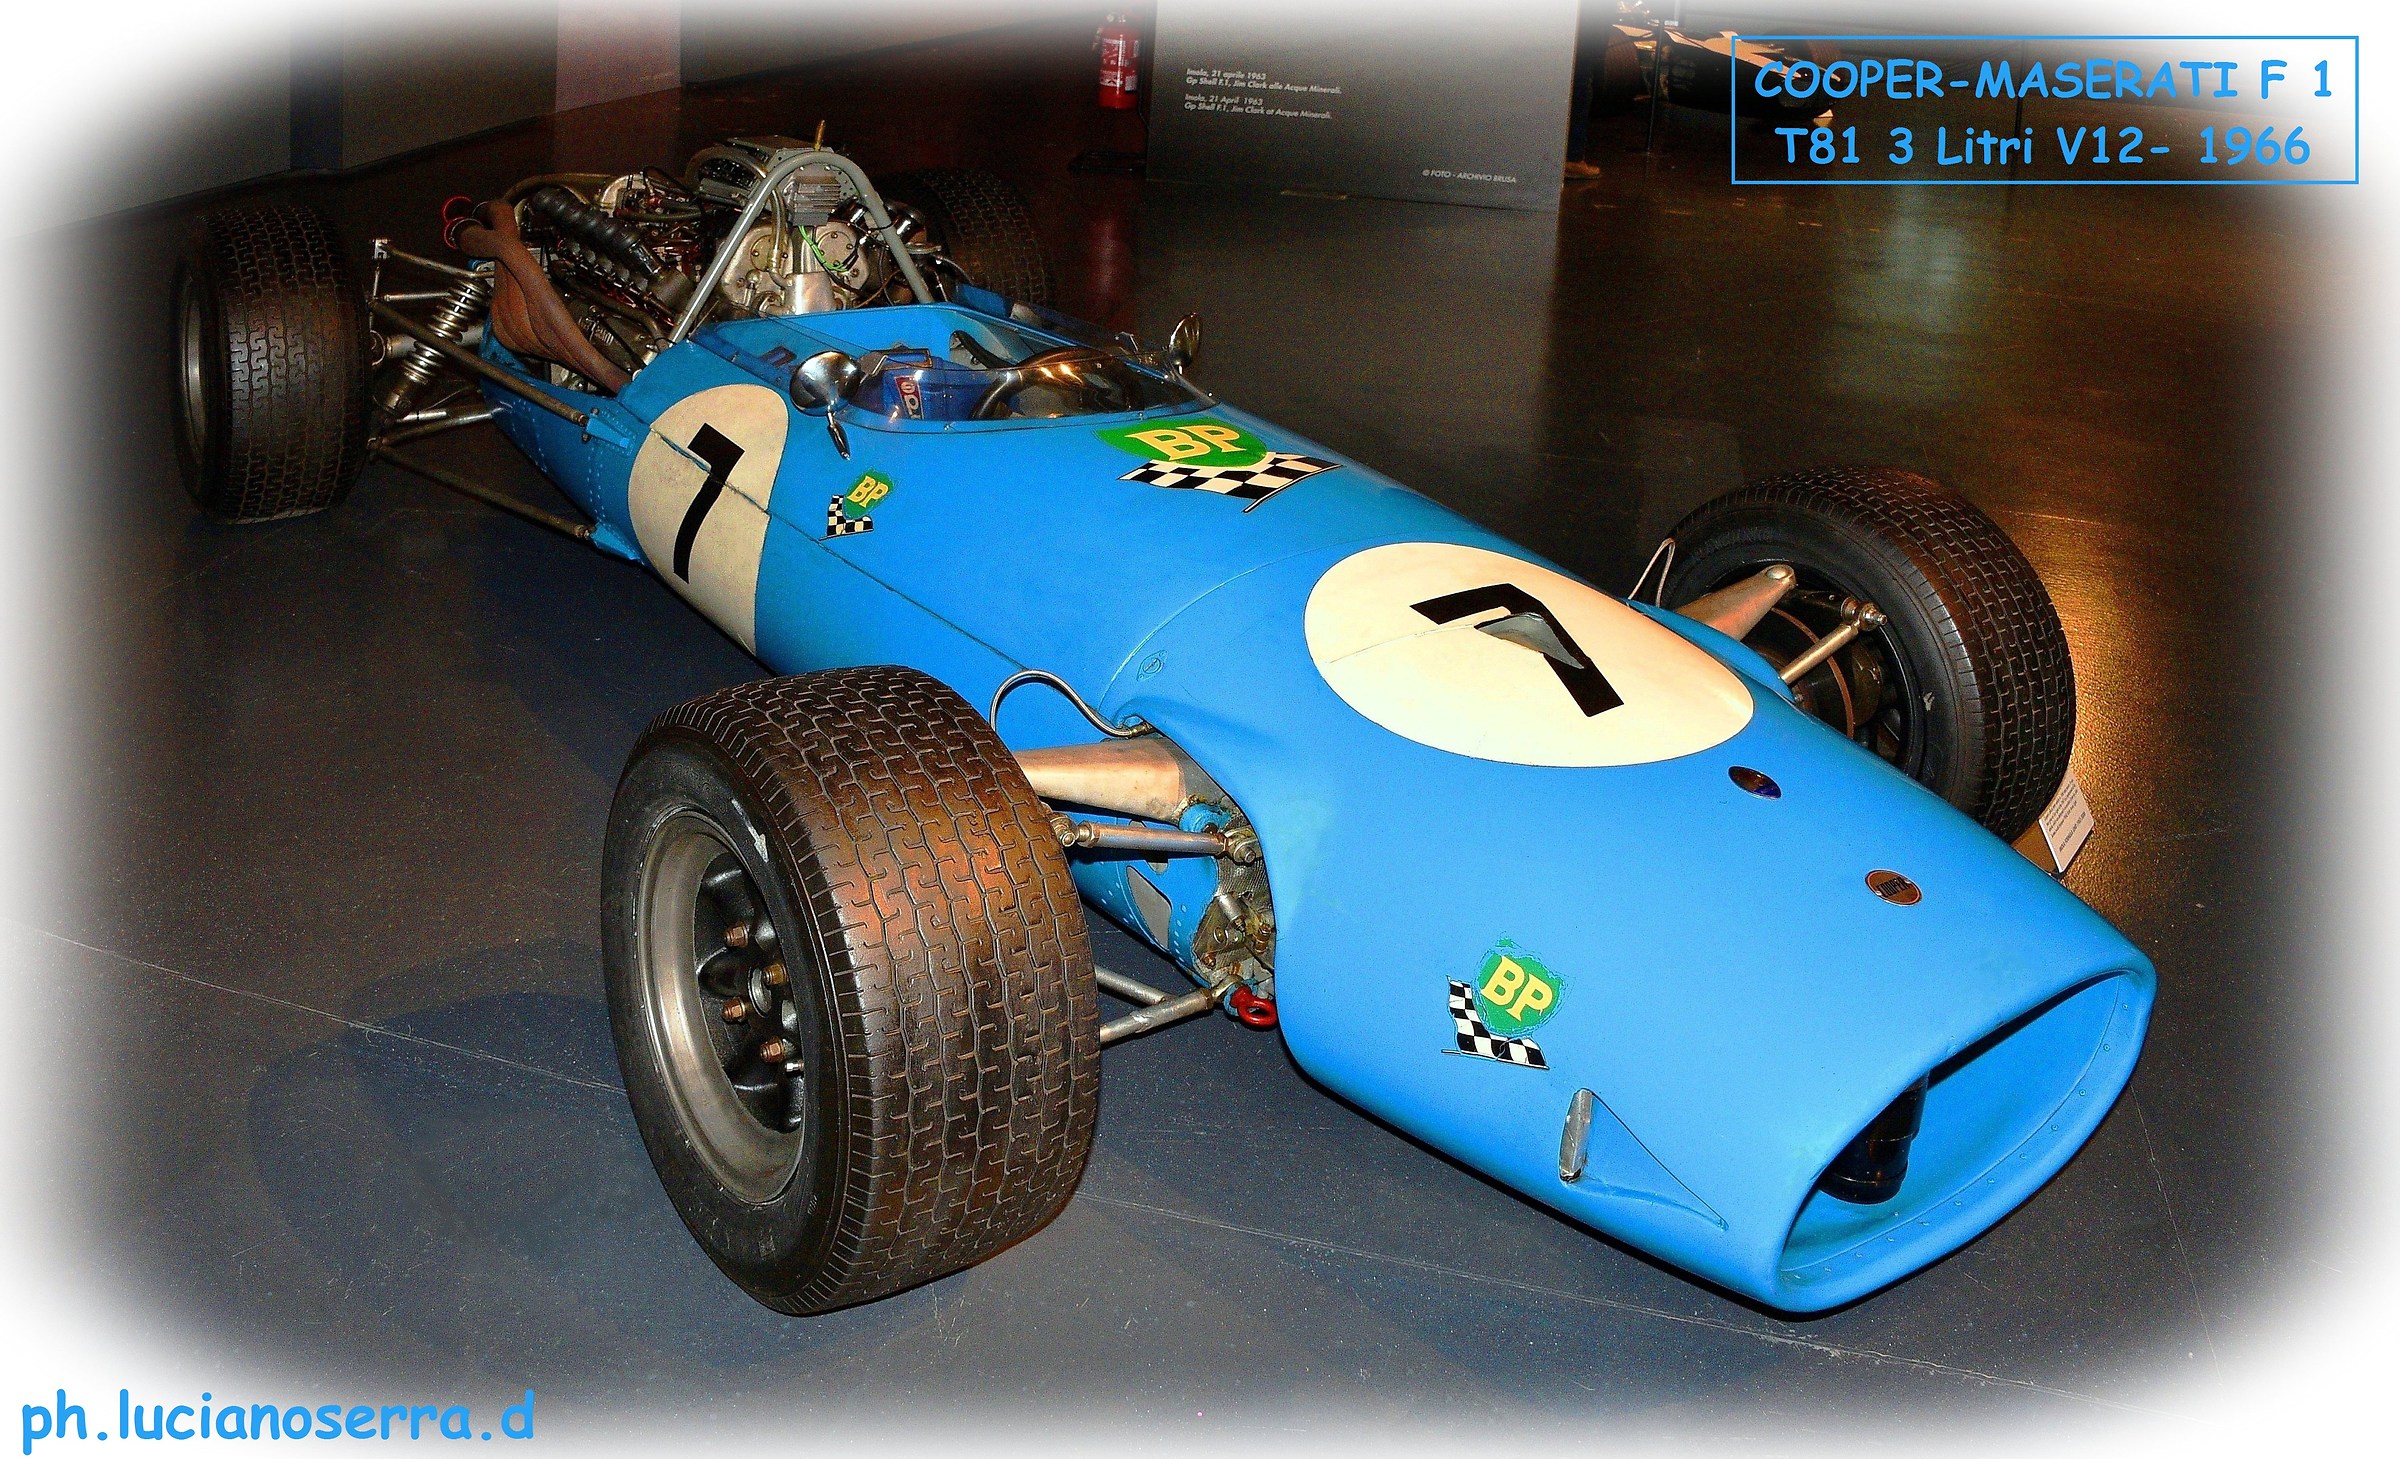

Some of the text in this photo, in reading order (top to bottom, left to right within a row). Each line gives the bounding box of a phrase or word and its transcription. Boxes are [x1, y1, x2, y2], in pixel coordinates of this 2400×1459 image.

[1186, 76, 1198, 86] Gp
[1199, 77, 1218, 85] Shell
[1233, 80, 1247, 88] Jim
[1247, 80, 1267, 89] Clark
[1268, 82, 1283, 90] alle
[1284, 83, 1309, 93] Acque
[1211, 69, 1221, 78] 21
[1222, 71, 1245, 80] aprile
[1247, 72, 1267, 80] 1963
[1184, 101, 1197, 111] Gp
[1197, 102, 1216, 111] Shell
[1230, 105, 1244, 113] Jim
[1244, 106, 1265, 115] Clark
[1275, 108, 1299, 118] Acque
[1209, 95, 1219, 103] 21
[1220, 95, 1240, 105] April
[1243, 97, 1263, 106] 1963
[1430, 169, 1452, 178] FOTO
[1457, 172, 1492, 181] ARCHIVIO
[1124, 424, 1247, 461] BP
[673, 422, 746, 585] 7
[846, 475, 889, 508] BP
[1409, 583, 1624, 717] 7
[1480, 955, 1553, 1022] BP
